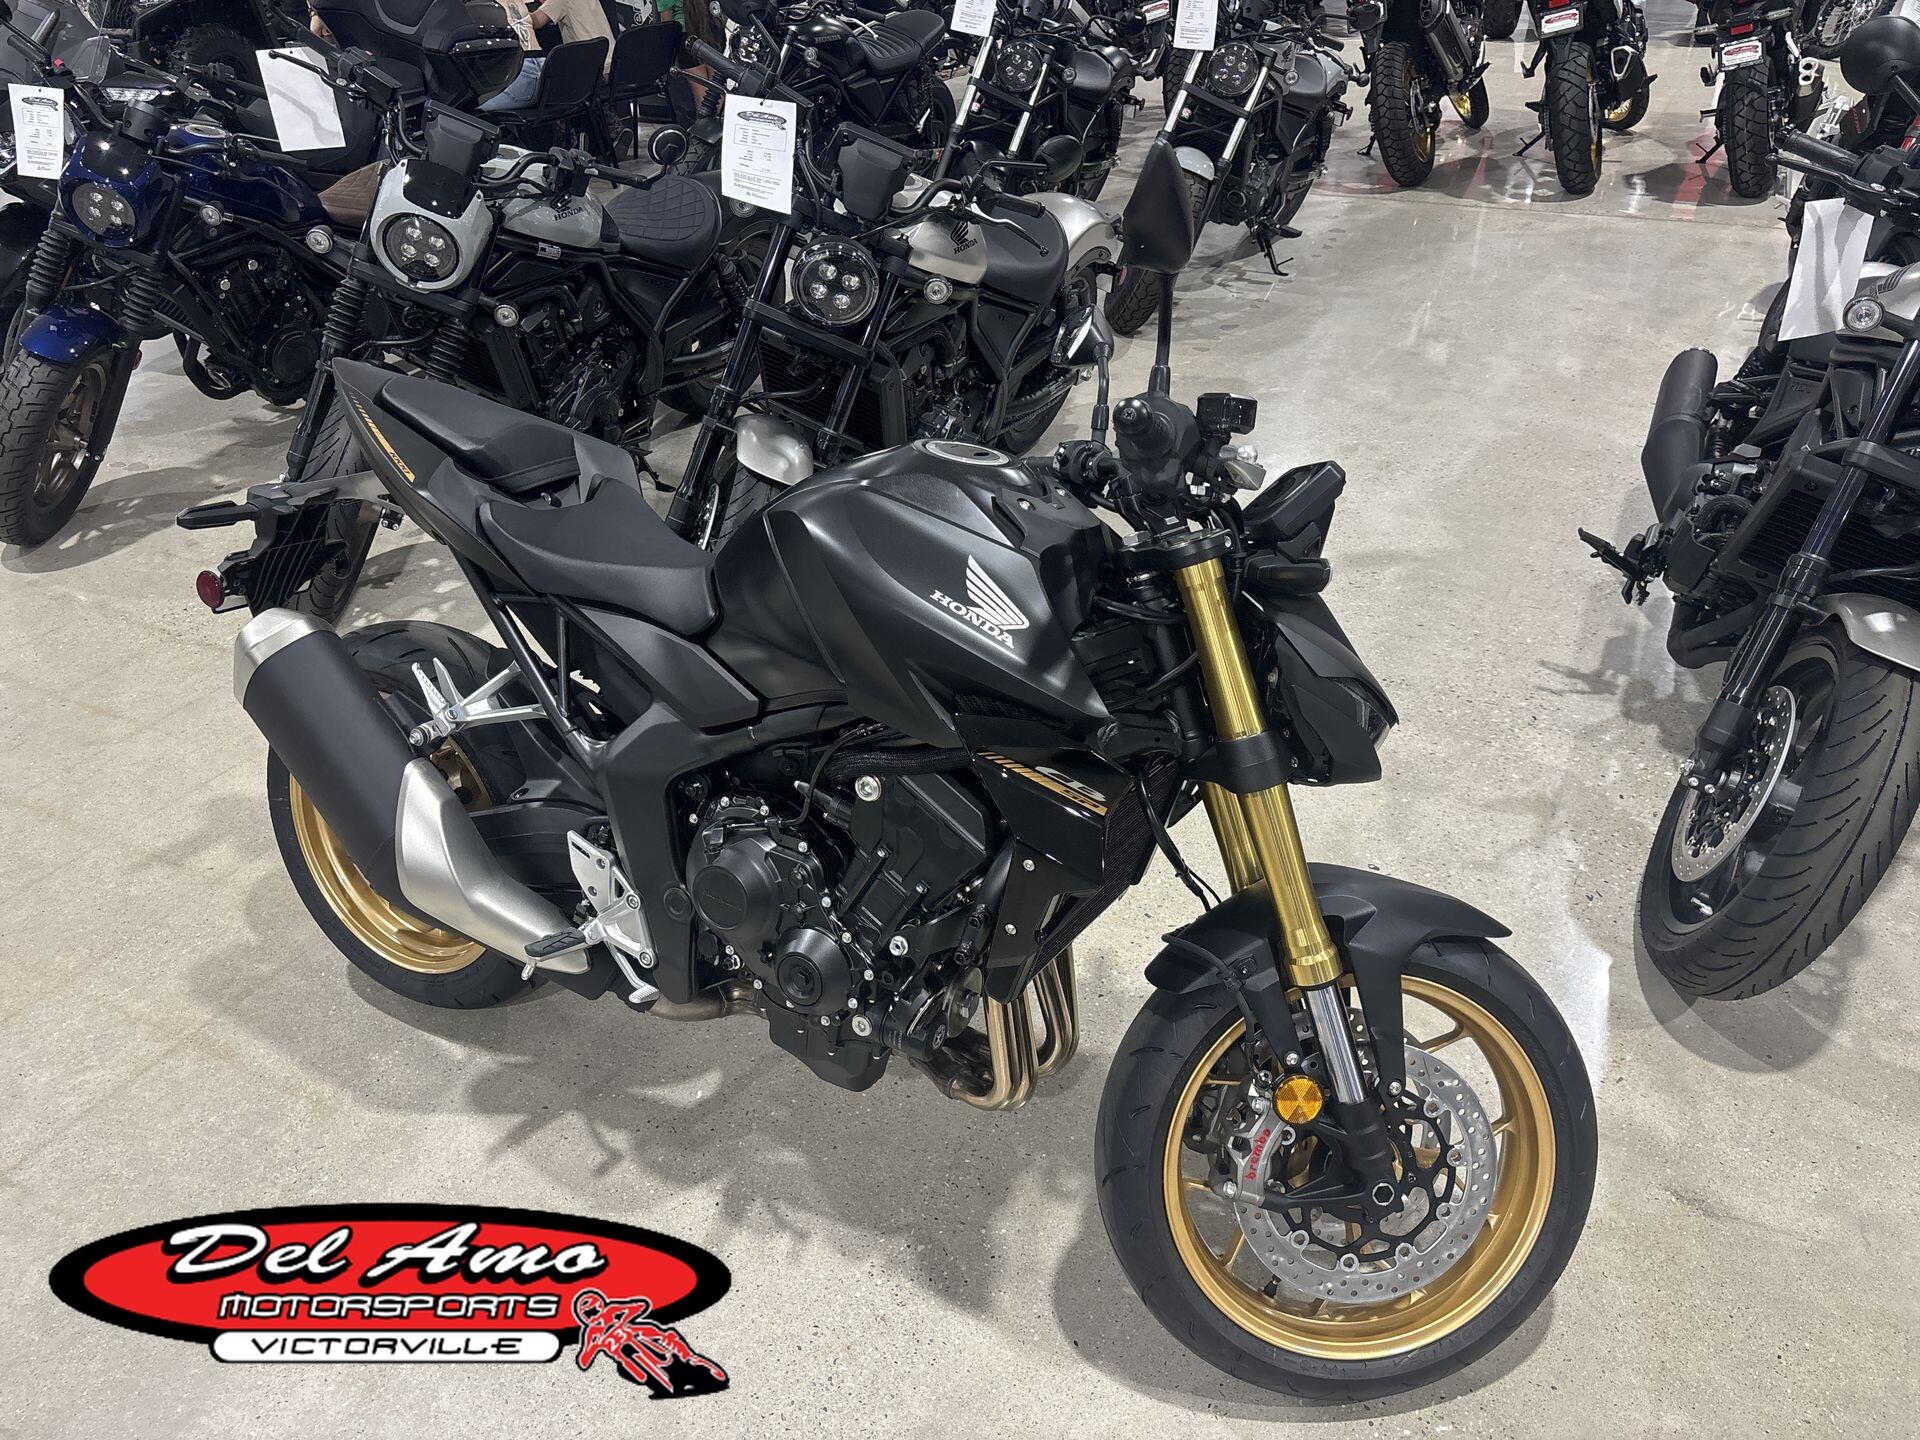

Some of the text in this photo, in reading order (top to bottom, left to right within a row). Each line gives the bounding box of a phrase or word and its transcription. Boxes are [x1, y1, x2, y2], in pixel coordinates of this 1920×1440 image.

[814, 34, 842, 44] HONDA
[553, 206, 584, 221] HONDA
[953, 238, 978, 255] HONDA
[930, 590, 1014, 649] HONDA
[1035, 765, 1106, 802] CB
[1244, 1128, 1271, 1180] brembo
